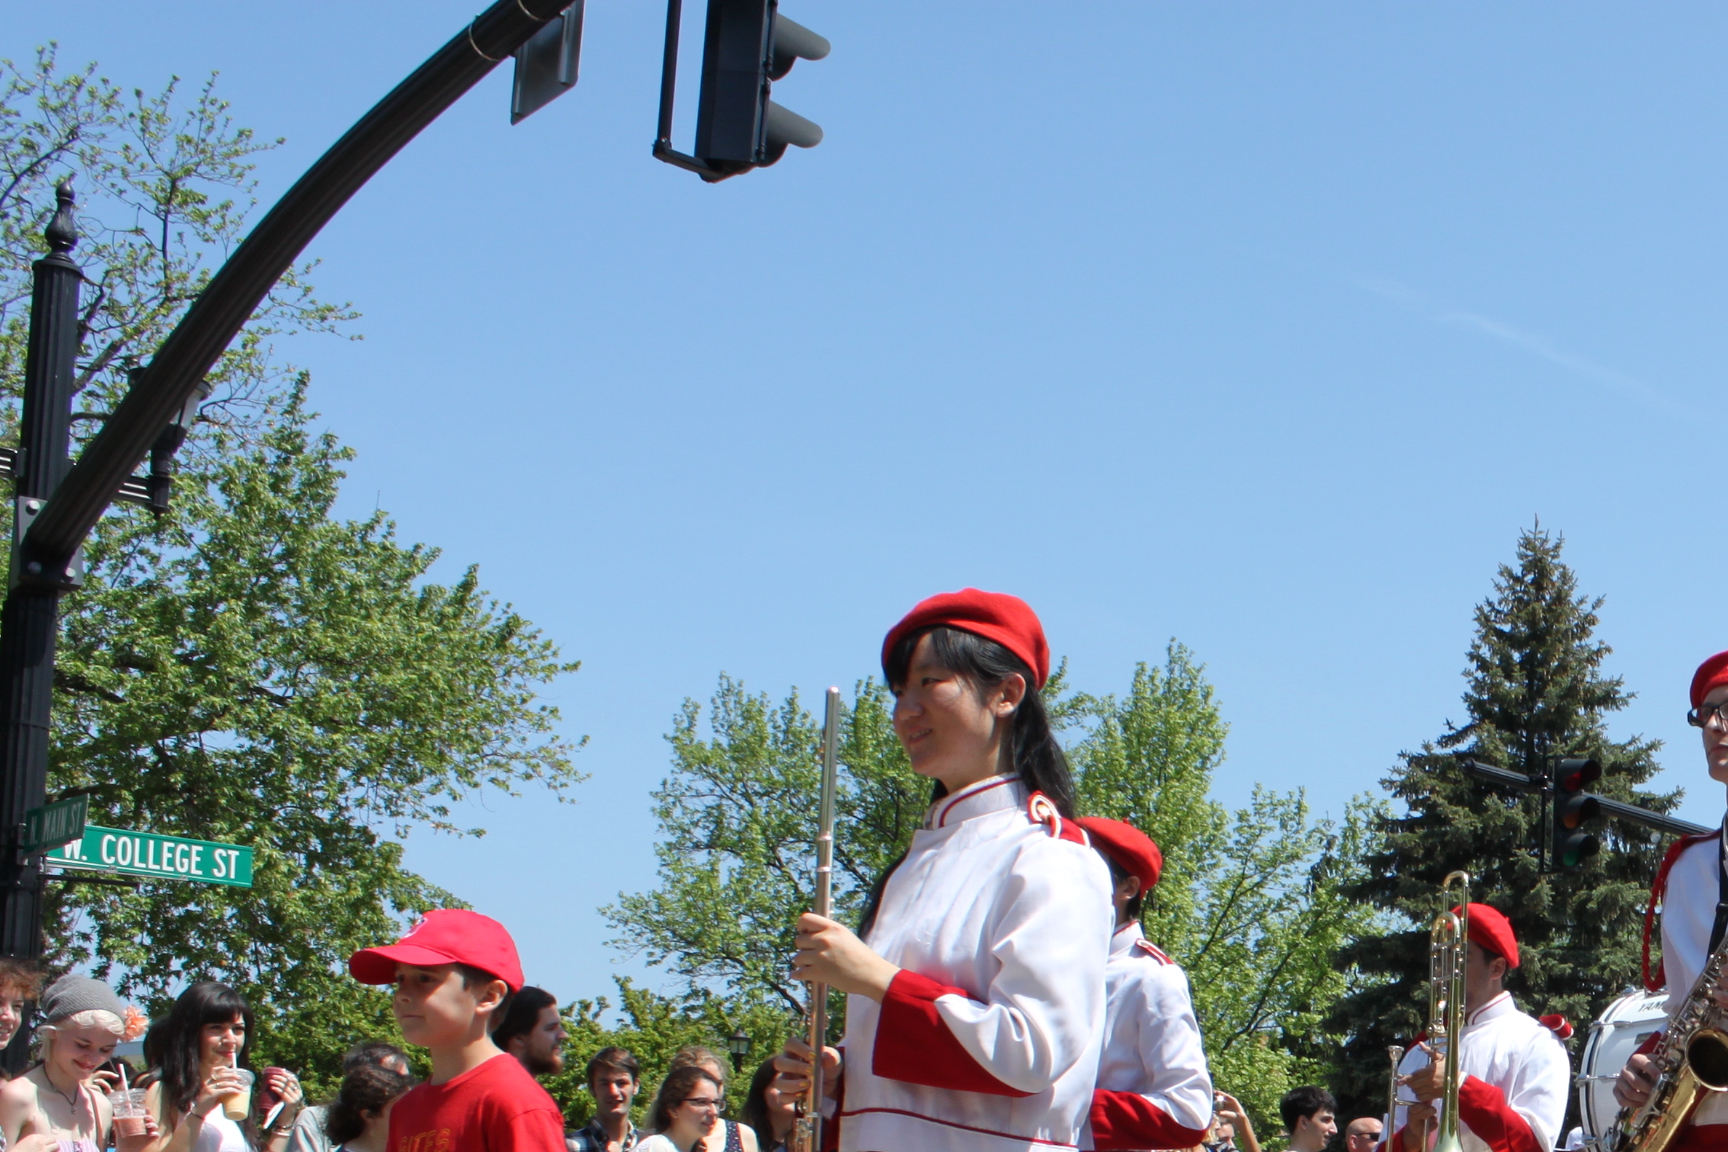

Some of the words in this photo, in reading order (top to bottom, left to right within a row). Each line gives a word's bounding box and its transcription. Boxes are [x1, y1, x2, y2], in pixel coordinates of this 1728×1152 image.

[42, 806, 68, 843] MAIN
[69, 801, 82, 835] ST
[101, 834, 204, 876] COLLEGE
[212, 848, 240, 879] ST
